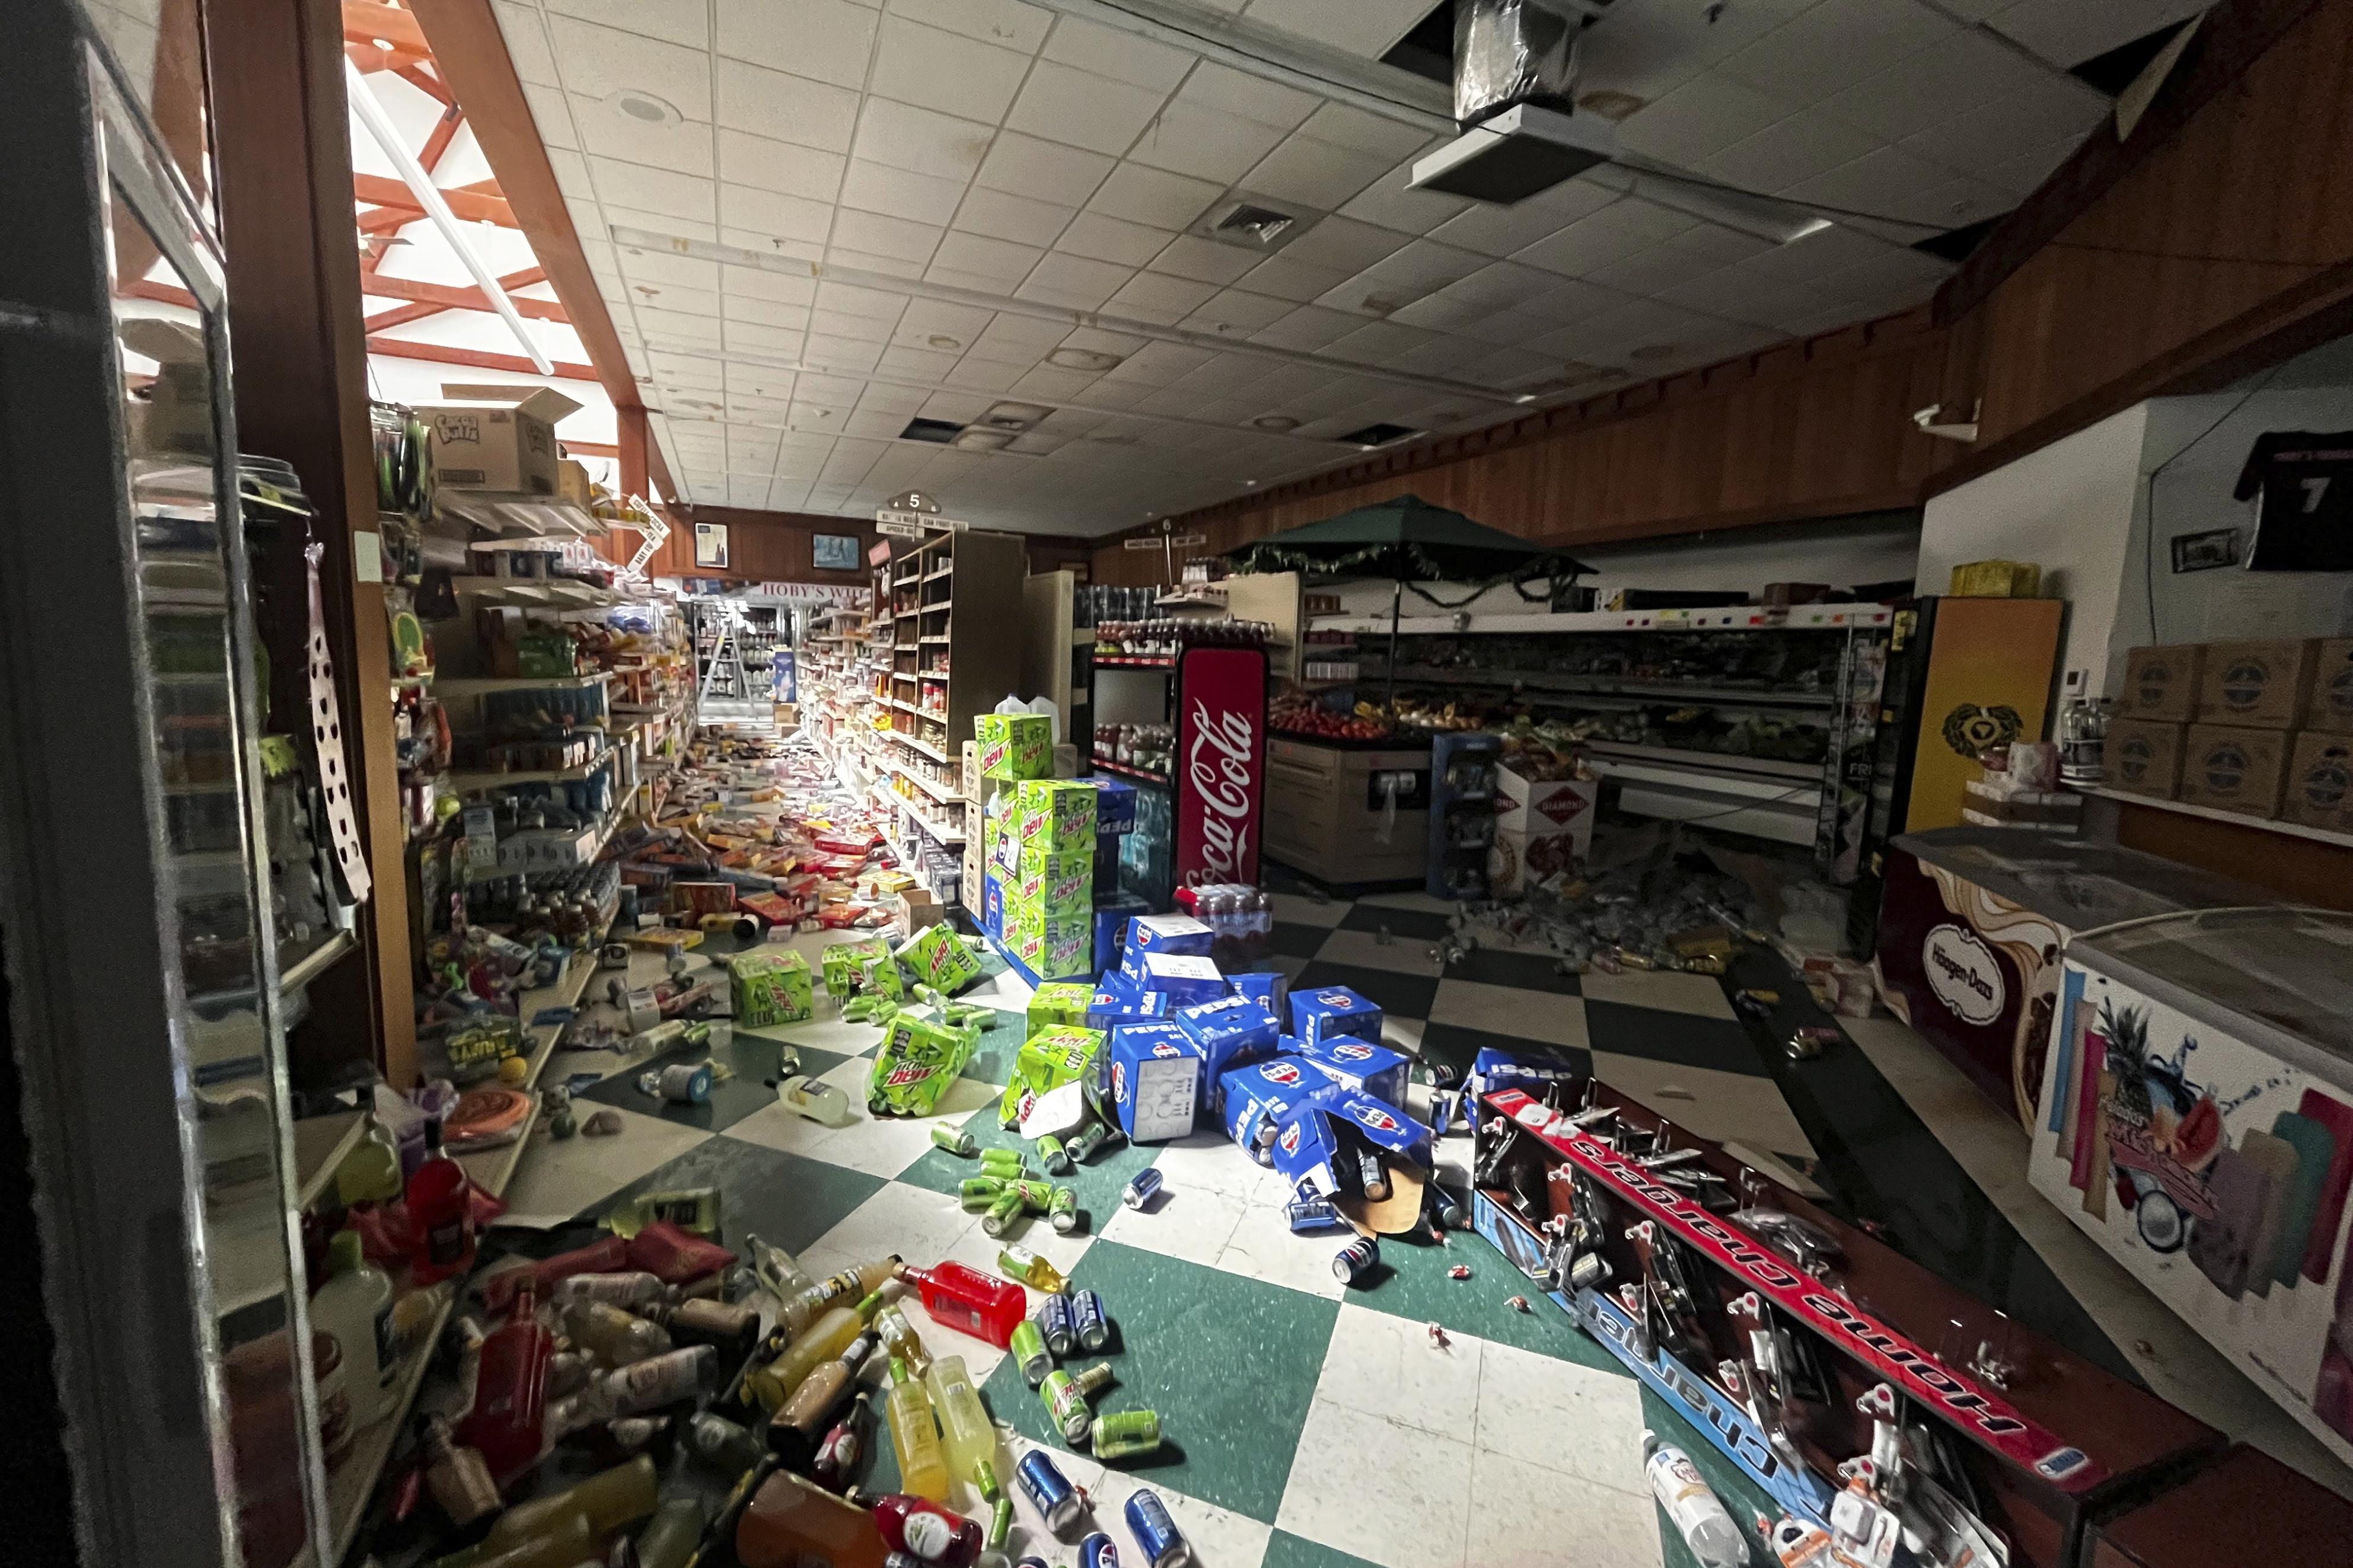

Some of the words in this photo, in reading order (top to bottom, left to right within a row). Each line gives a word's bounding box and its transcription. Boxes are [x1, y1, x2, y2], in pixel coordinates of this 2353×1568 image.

[910, 494, 920, 507] 5
[2300, 477, 2332, 513] 7
[1163, 519, 1171, 531] 6
[764, 584, 824, 598] HOBY'S
[1542, 800, 1585, 811] DIAMOND
[1098, 820, 1131, 834] PEP
[1933, 943, 1993, 1000] Häagen-Dazs
[1185, 995, 1251, 1019] PEPSI
[1122, 1024, 1179, 1035] PEPSI
[1491, 1064, 1572, 1080] PEPSI
[1235, 1098, 1259, 1147] PEP
[1571, 1141, 1800, 1289] Chargers
[1803, 1295, 2027, 1433] Home
[1574, 1295, 1778, 1479] Charger
